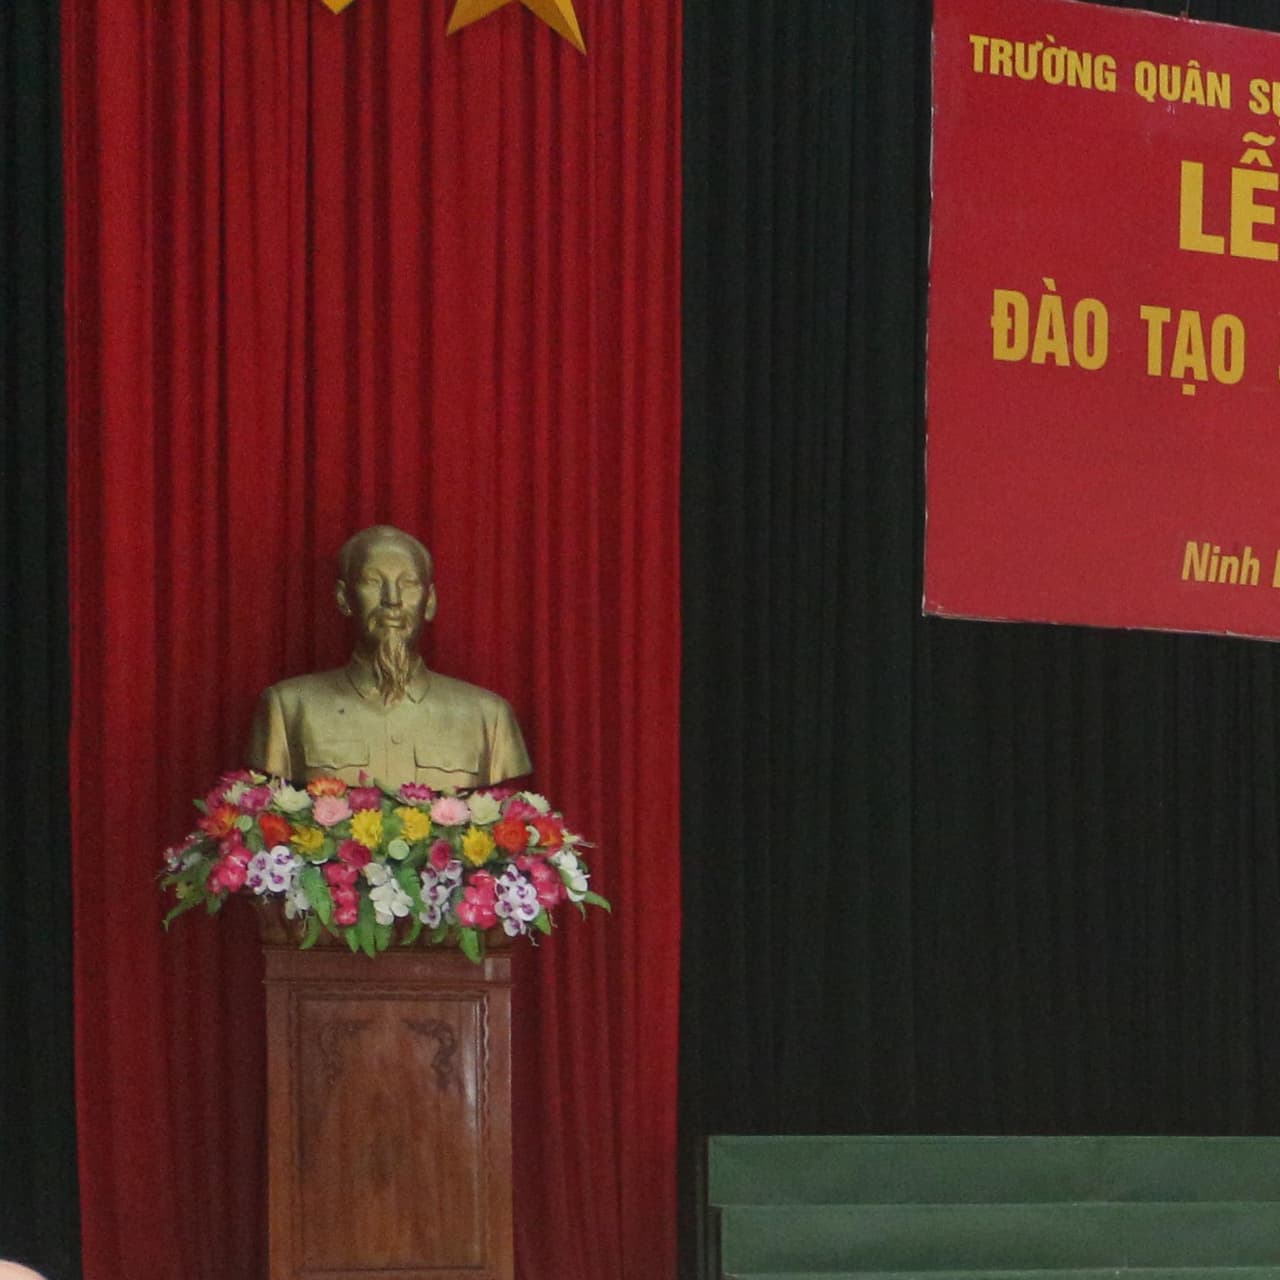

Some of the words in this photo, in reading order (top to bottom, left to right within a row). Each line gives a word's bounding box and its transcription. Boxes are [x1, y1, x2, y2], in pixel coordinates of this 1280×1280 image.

[969, 34, 1117, 93] TRƯỜNG
[1134, 59, 1231, 110] QUÂN
[1179, 131, 1280, 262] LỄ
[990, 277, 1109, 370] ĐÀO
[1140, 304, 1246, 396] TẠO
[1181, 540, 1261, 586] Ninh
